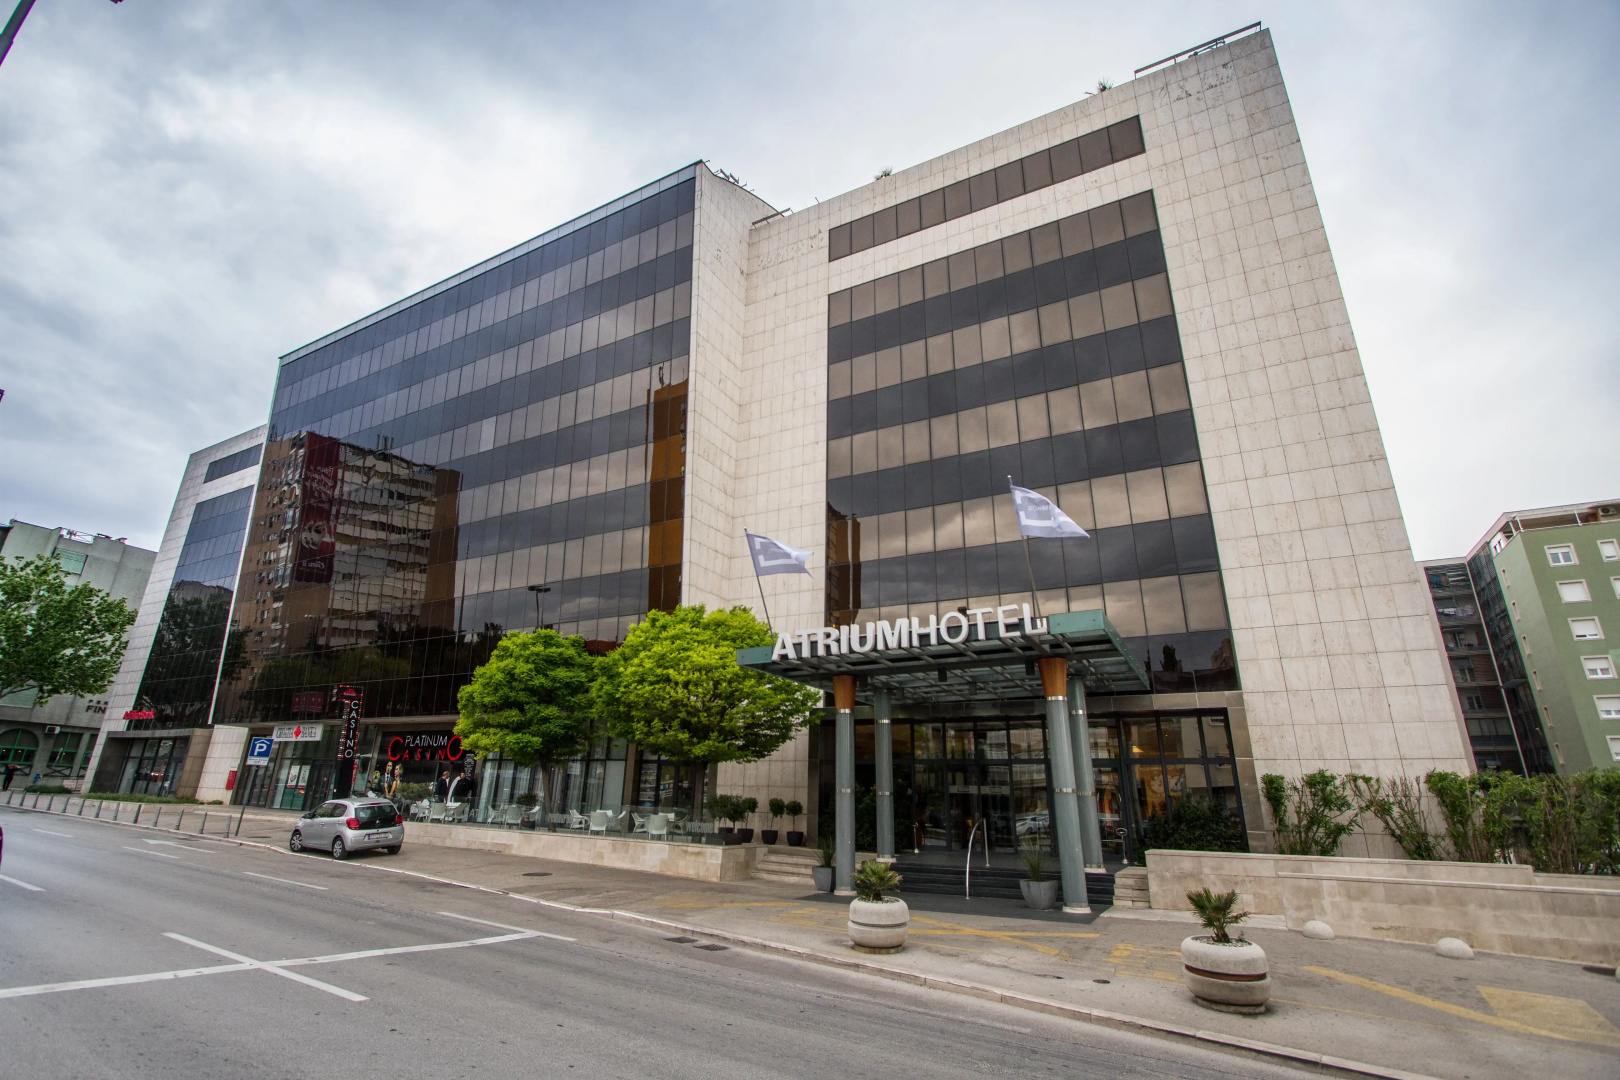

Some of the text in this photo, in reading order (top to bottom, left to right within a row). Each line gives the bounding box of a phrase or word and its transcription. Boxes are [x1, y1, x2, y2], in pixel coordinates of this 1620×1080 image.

[344, 700, 359, 758] CASINO
[387, 735, 464, 761] CASINO
[404, 735, 448, 747] PLATINUM
[254, 743, 267, 756] P
[686, 820, 713, 834] welcome
